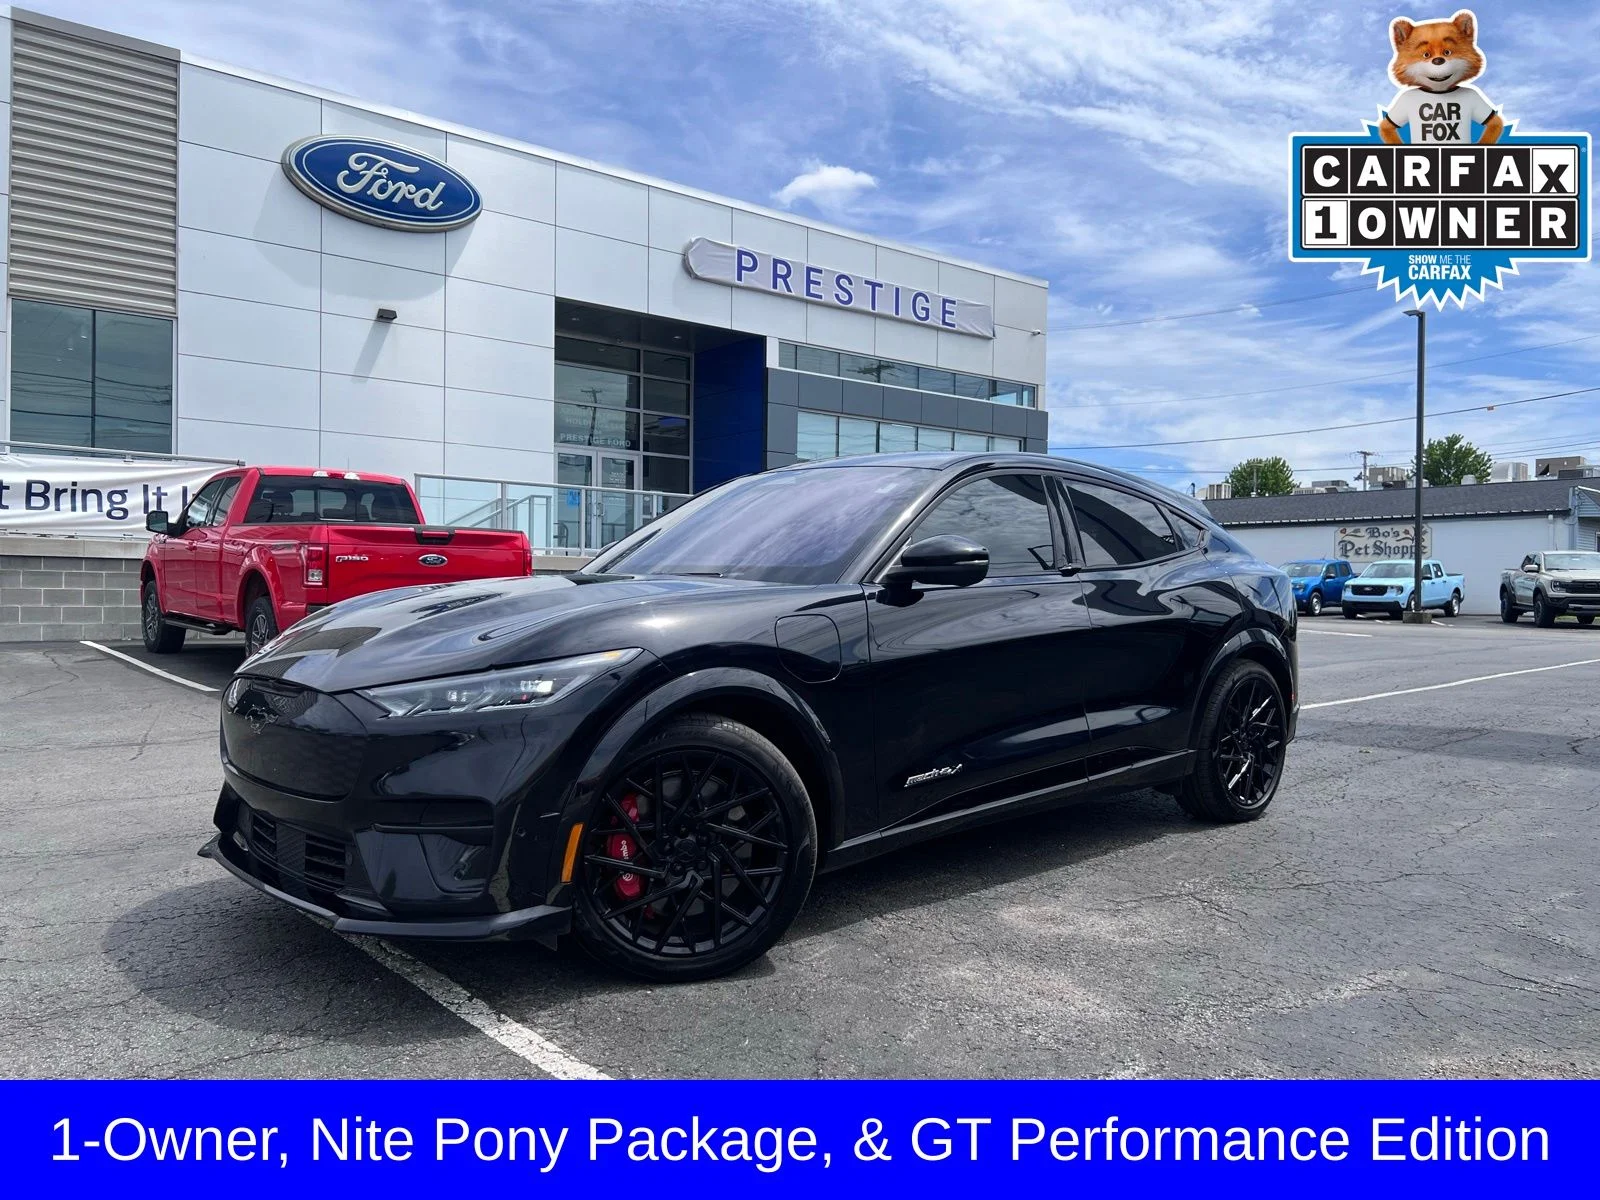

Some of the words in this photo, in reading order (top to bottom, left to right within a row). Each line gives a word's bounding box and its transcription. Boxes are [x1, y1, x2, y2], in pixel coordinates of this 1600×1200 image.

[336, 152, 446, 211] Ford
[735, 248, 958, 329] PRESTIGE
[24, 479, 129, 521] Bring
[142, 483, 168, 515] It
[1338, 540, 1370, 558] Pet
[1365, 526, 1400, 539] Bo's
